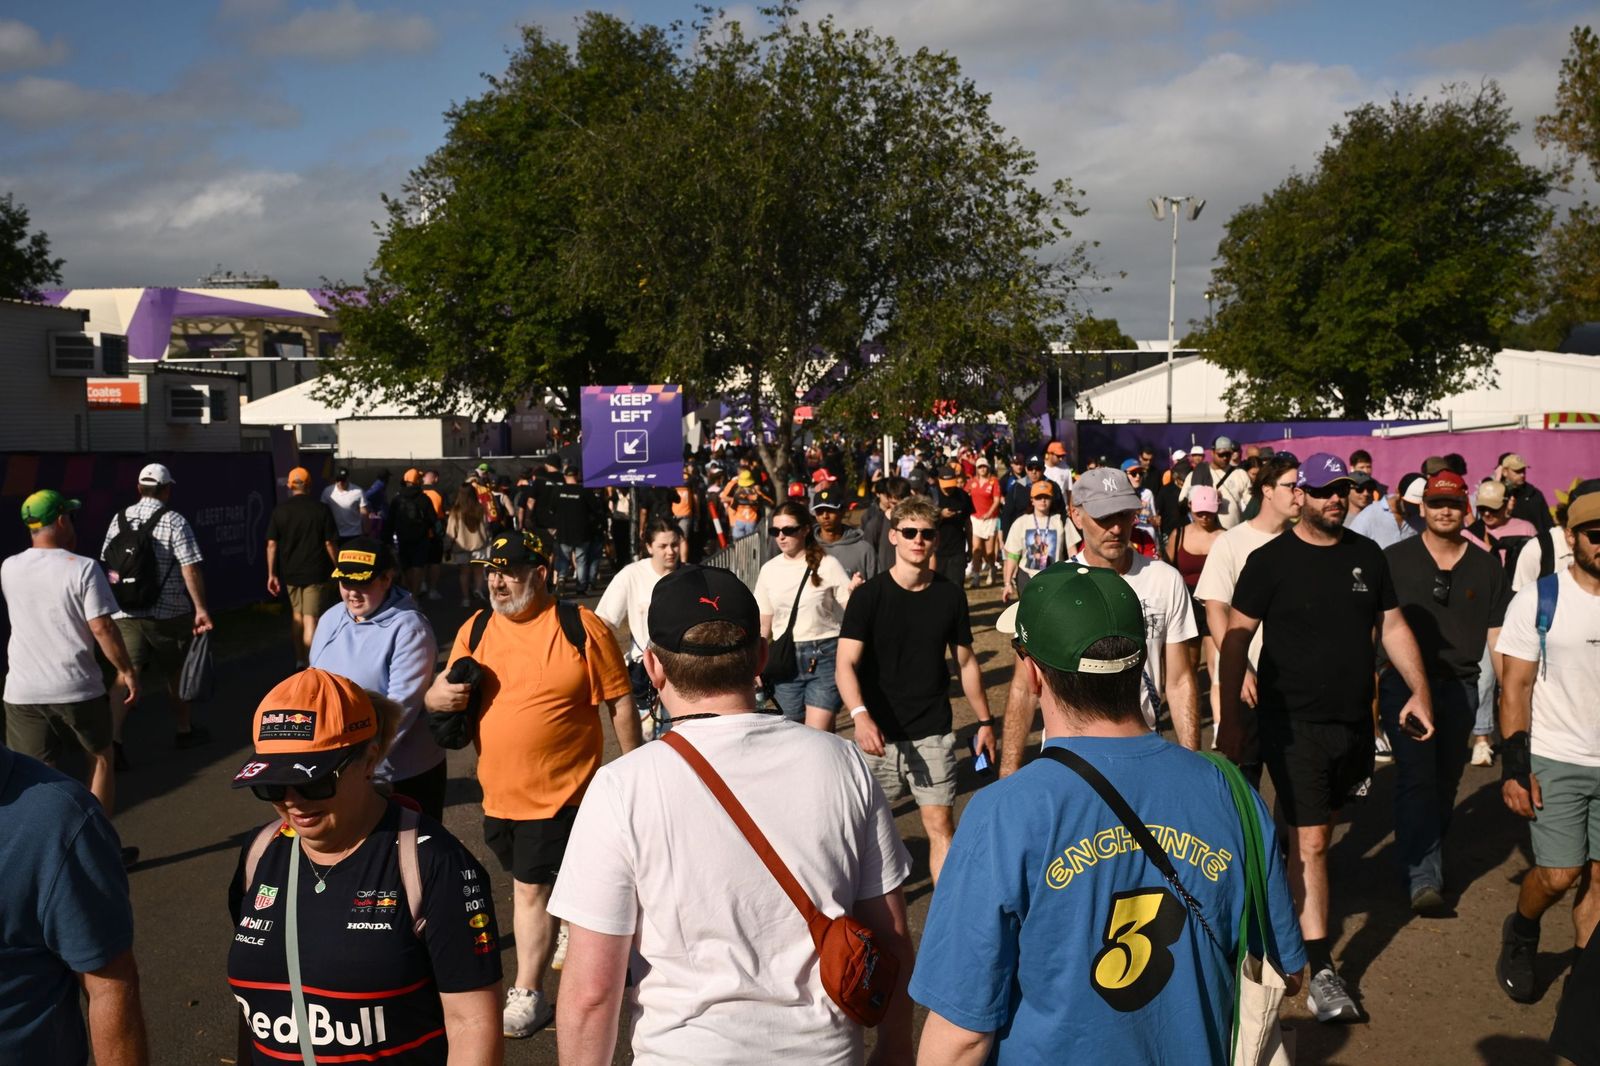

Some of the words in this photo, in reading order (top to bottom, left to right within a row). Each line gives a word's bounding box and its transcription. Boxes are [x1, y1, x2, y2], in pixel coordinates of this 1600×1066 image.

[87, 387, 122, 397] Coates
[610, 393, 653, 406] KEEP
[611, 410, 652, 422] LEFT
[225, 504, 245, 522] PARK
[234, 762, 270, 780] 33
[259, 886, 277, 897] AG
[347, 922, 392, 931] HONDA
[235, 933, 266, 946] ORACLE
[1093, 890, 1172, 996] 3
